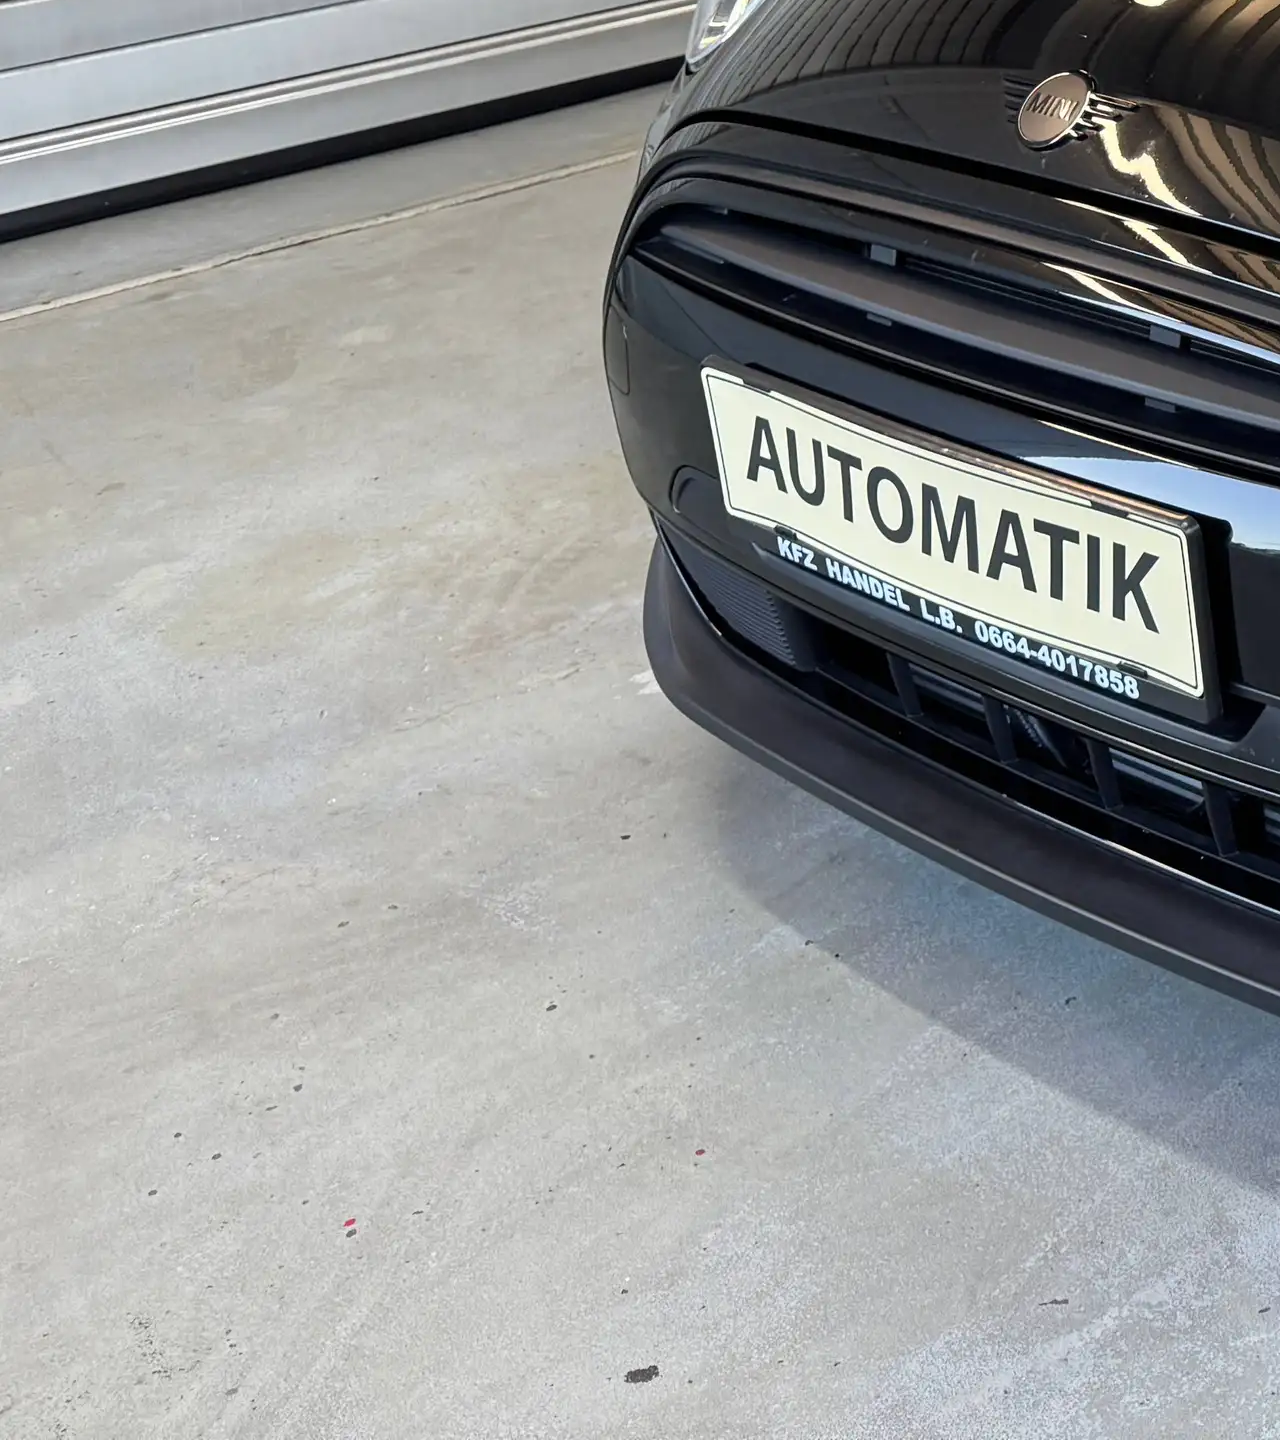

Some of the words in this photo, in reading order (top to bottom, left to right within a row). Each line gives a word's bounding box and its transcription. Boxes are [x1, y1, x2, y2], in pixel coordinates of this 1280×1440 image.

[746, 415, 1160, 635] AUTOMATIK
[777, 536, 818, 571] KFZ
[825, 557, 911, 612] HANDEL
[920, 598, 963, 634] L.B.
[974, 620, 1140, 700] 0664-4017858
